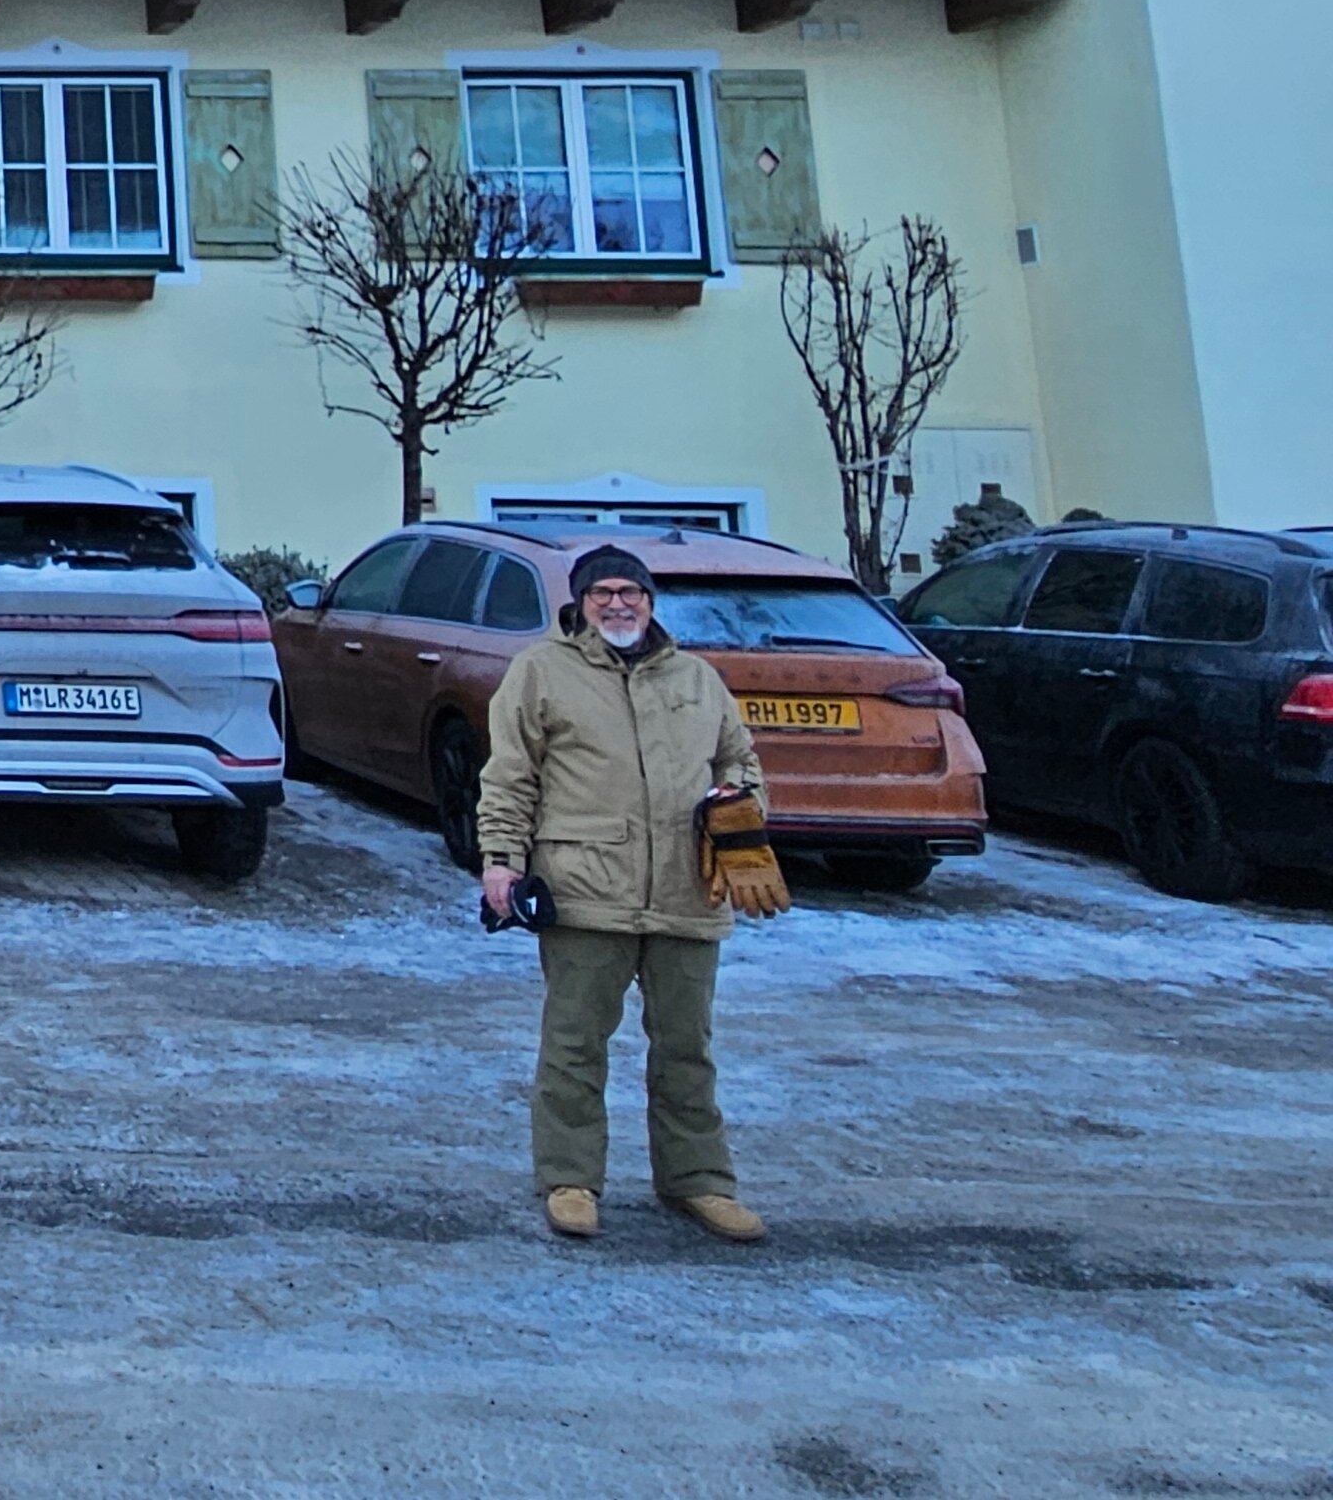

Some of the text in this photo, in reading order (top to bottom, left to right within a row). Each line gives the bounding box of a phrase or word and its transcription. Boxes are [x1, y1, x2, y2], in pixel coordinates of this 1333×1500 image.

[19, 686, 32, 708] M
[44, 687, 70, 709] LR
[745, 701, 843, 726] RH 1997
